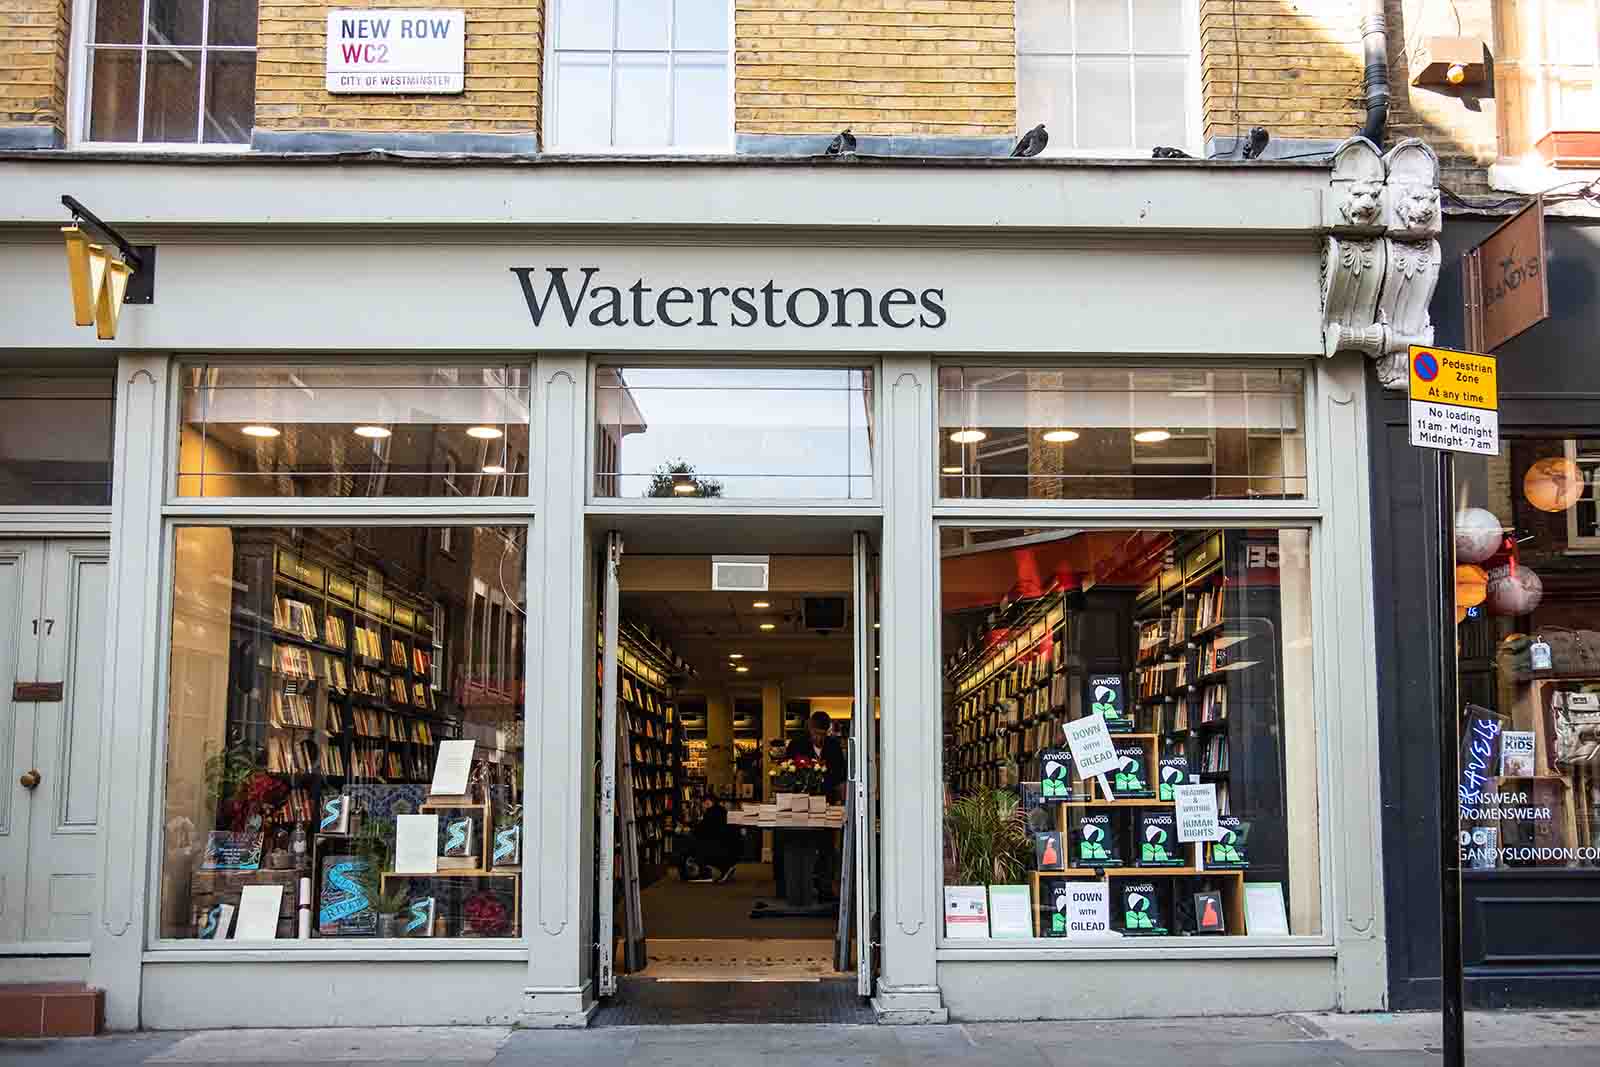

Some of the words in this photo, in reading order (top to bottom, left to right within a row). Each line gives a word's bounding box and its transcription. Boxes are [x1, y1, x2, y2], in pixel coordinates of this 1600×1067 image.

[341, 19, 391, 39] NEW
[401, 19, 451, 39] ROW
[341, 43, 390, 64] WC2
[340, 76, 360, 86] CITY
[366, 76, 377, 86] OF
[380, 76, 451, 86] WESTMINSTER
[509, 266, 947, 329] Waterstones
[1442, 358, 1493, 374] Pedestrian
[1456, 372, 1479, 384] Zone
[1428, 386, 1440, 397] At
[1442, 389, 1460, 401] any
[1463, 392, 1484, 403] time
[1429, 407, 1443, 418] No
[1446, 409, 1481, 424] loading
[1450, 423, 1493, 438] Midnight
[1420, 432, 1463, 447] Midnight
[32, 619, 55, 635] 17
[1072, 724, 1101, 741] DOWN
[1082, 741, 1100, 751] WITH
[1505, 740, 1533, 750] KIDS
[1080, 750, 1113, 768] GILEAD
[1143, 817, 1172, 825] ATWOOD
[1183, 819, 1214, 828] HUMAN
[1183, 829, 1215, 837] RIGHTS
[1125, 885, 1154, 893] ATWOOD
[1072, 892, 1102, 902] DOWN
[1079, 908, 1097, 916] WITH
[1071, 921, 1105, 931] GILEAD
